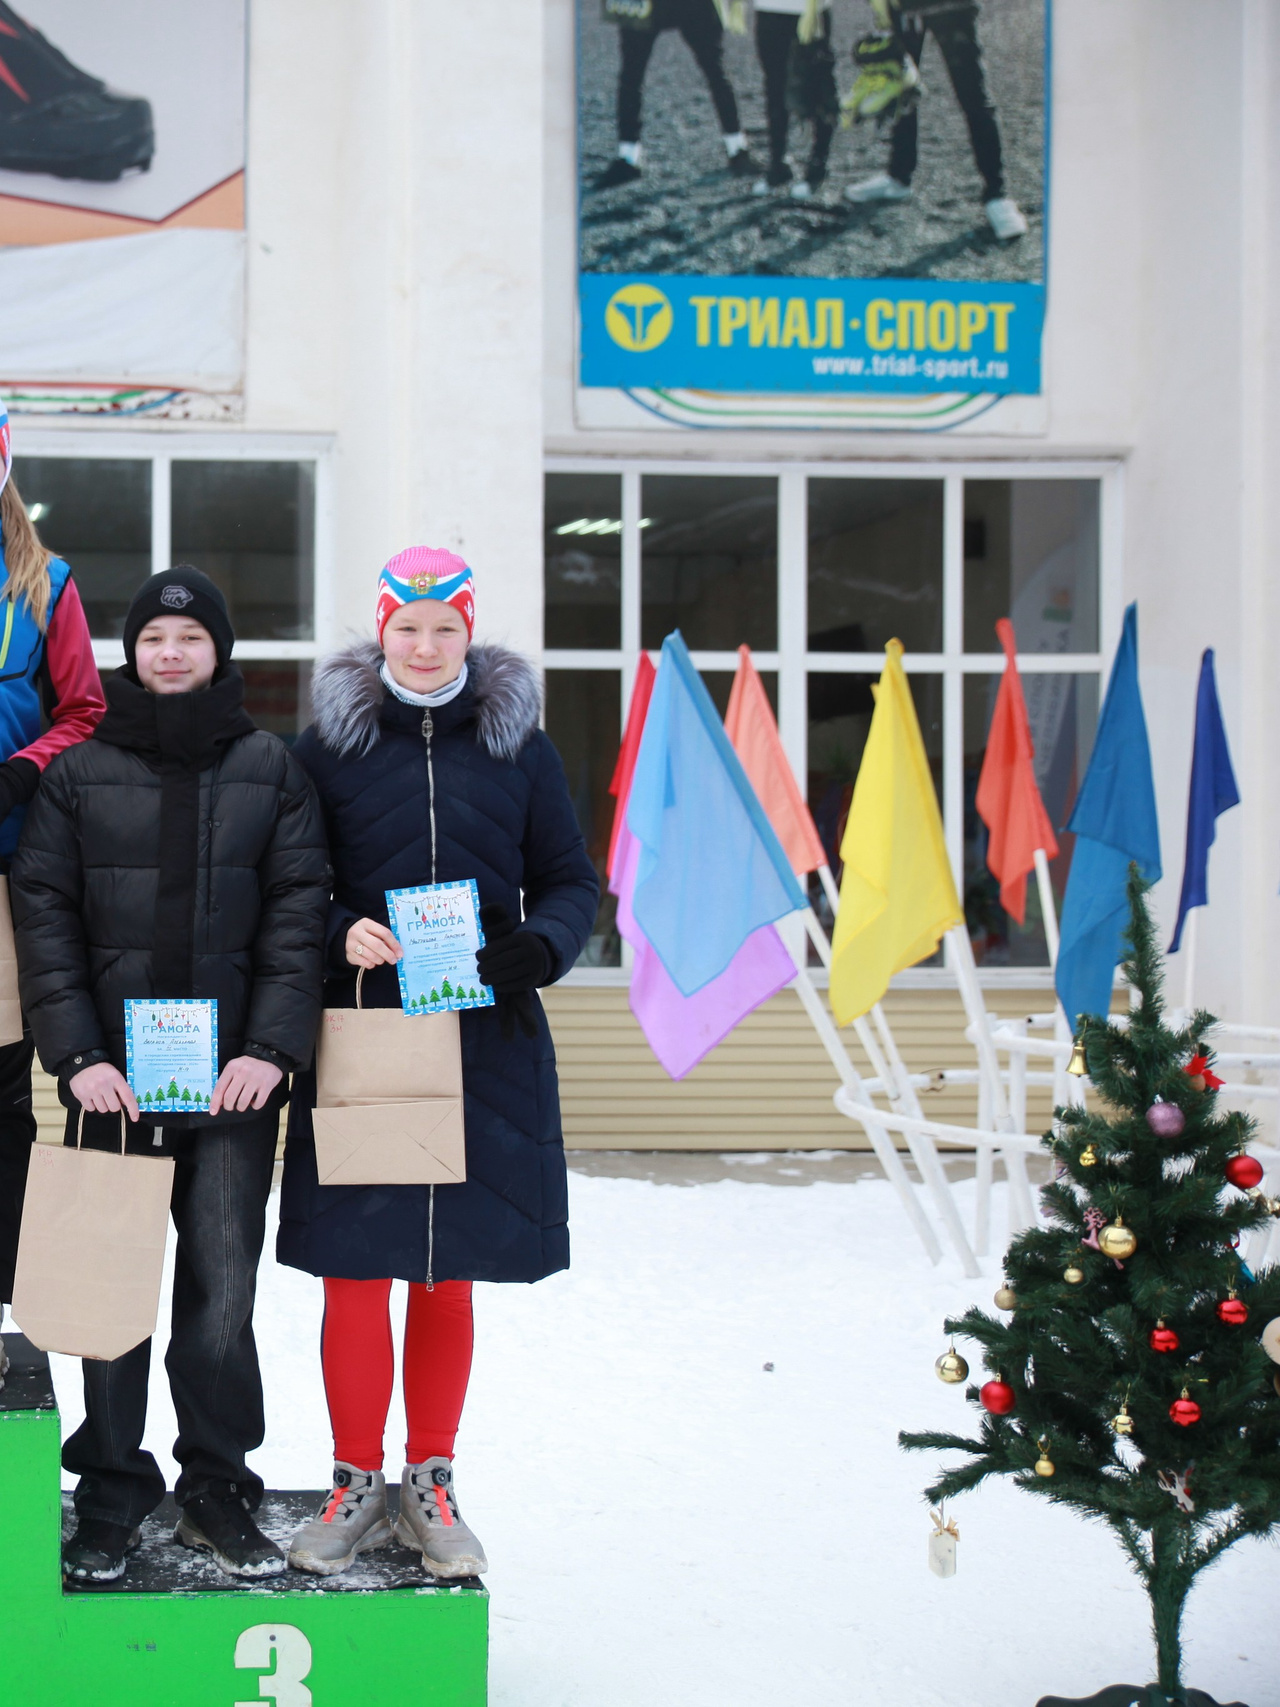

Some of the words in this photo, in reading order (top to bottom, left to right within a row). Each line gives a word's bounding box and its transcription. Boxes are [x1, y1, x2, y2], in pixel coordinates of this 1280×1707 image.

[813, 354, 1009, 381] www.trial-sport.ru
[407, 915, 465, 932] ГРАМОТА
[233, 1623, 312, 1707] 3
